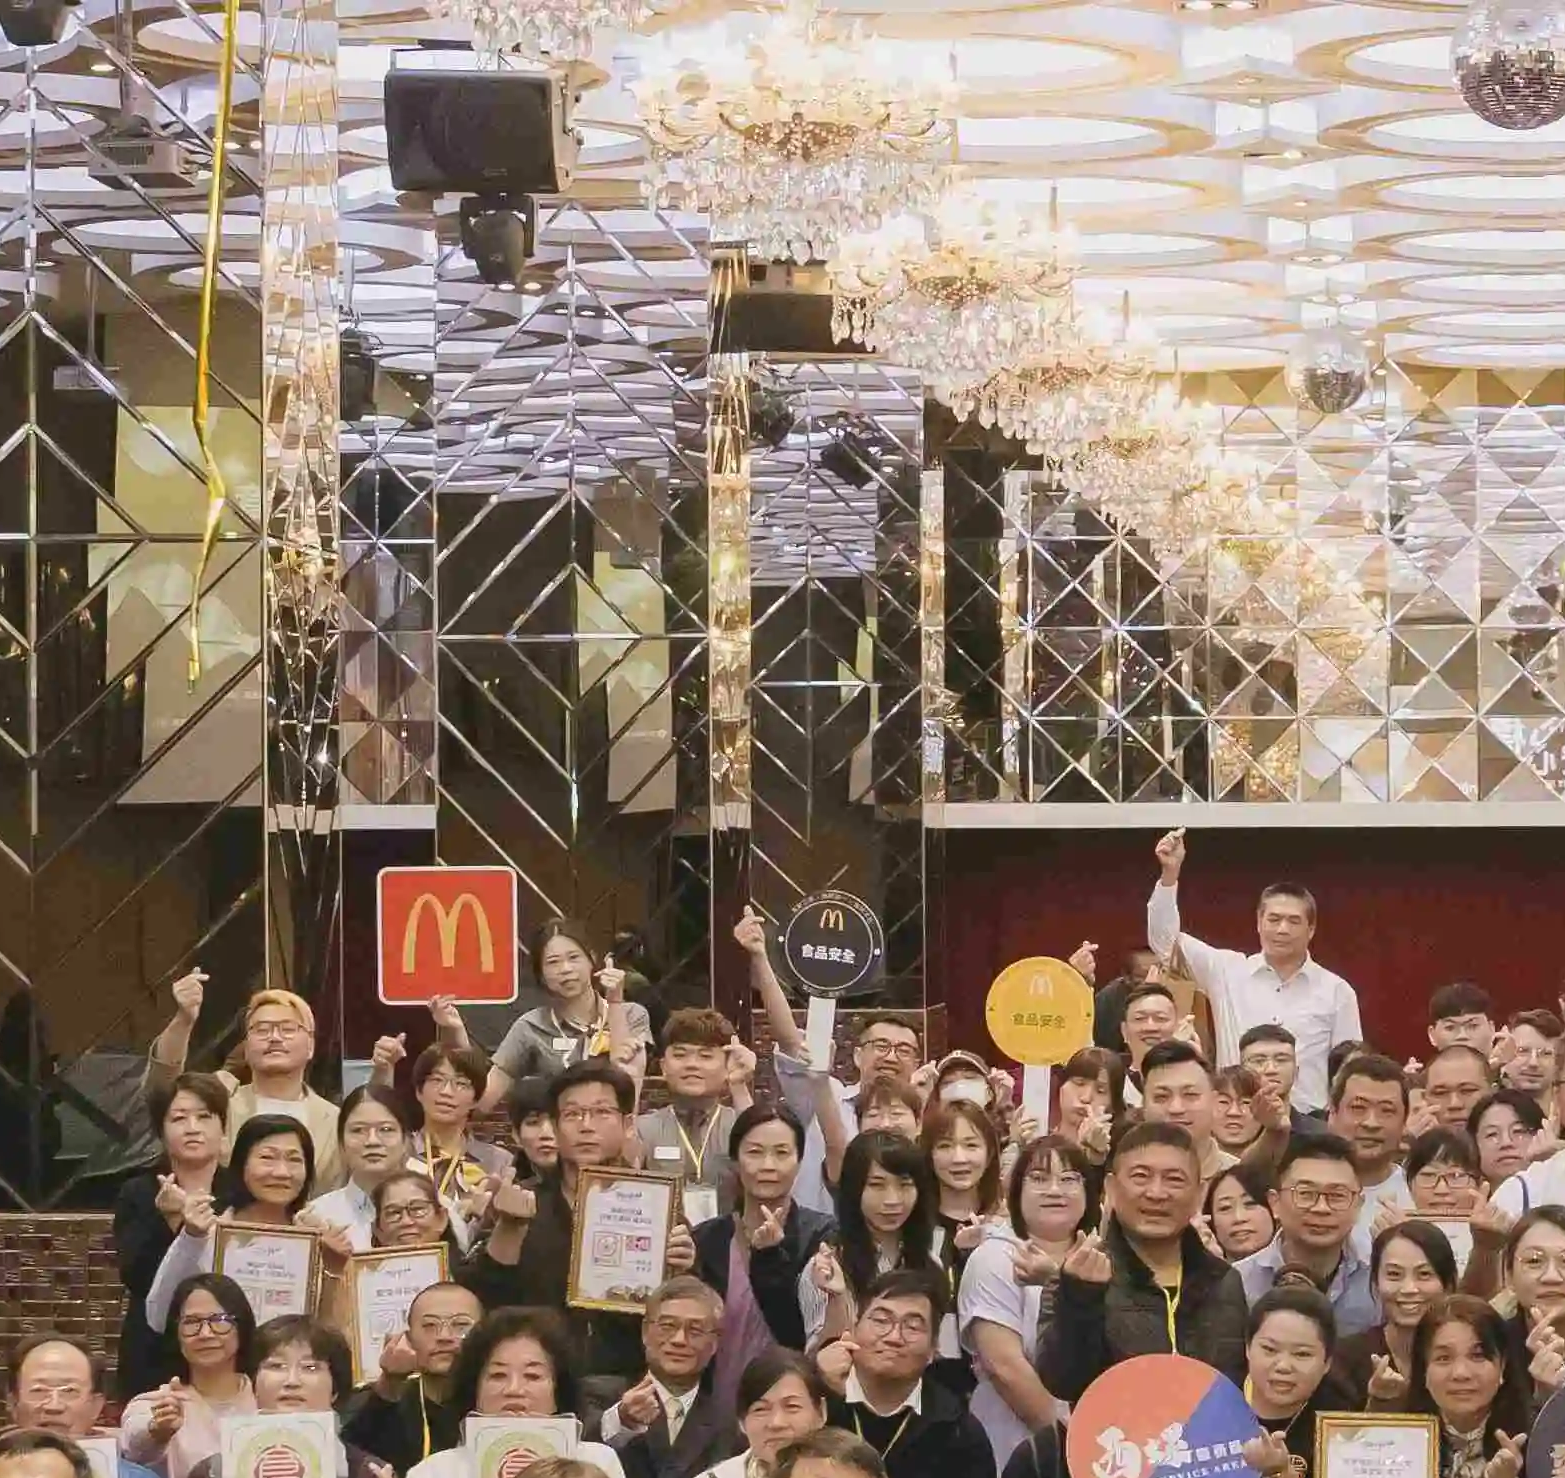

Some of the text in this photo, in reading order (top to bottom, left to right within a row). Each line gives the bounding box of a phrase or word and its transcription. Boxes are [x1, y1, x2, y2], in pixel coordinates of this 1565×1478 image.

[801, 943, 856, 964] 食品安全
[1011, 1012, 1067, 1029] 食品安全
[1213, 1459, 1248, 1474] AREA
